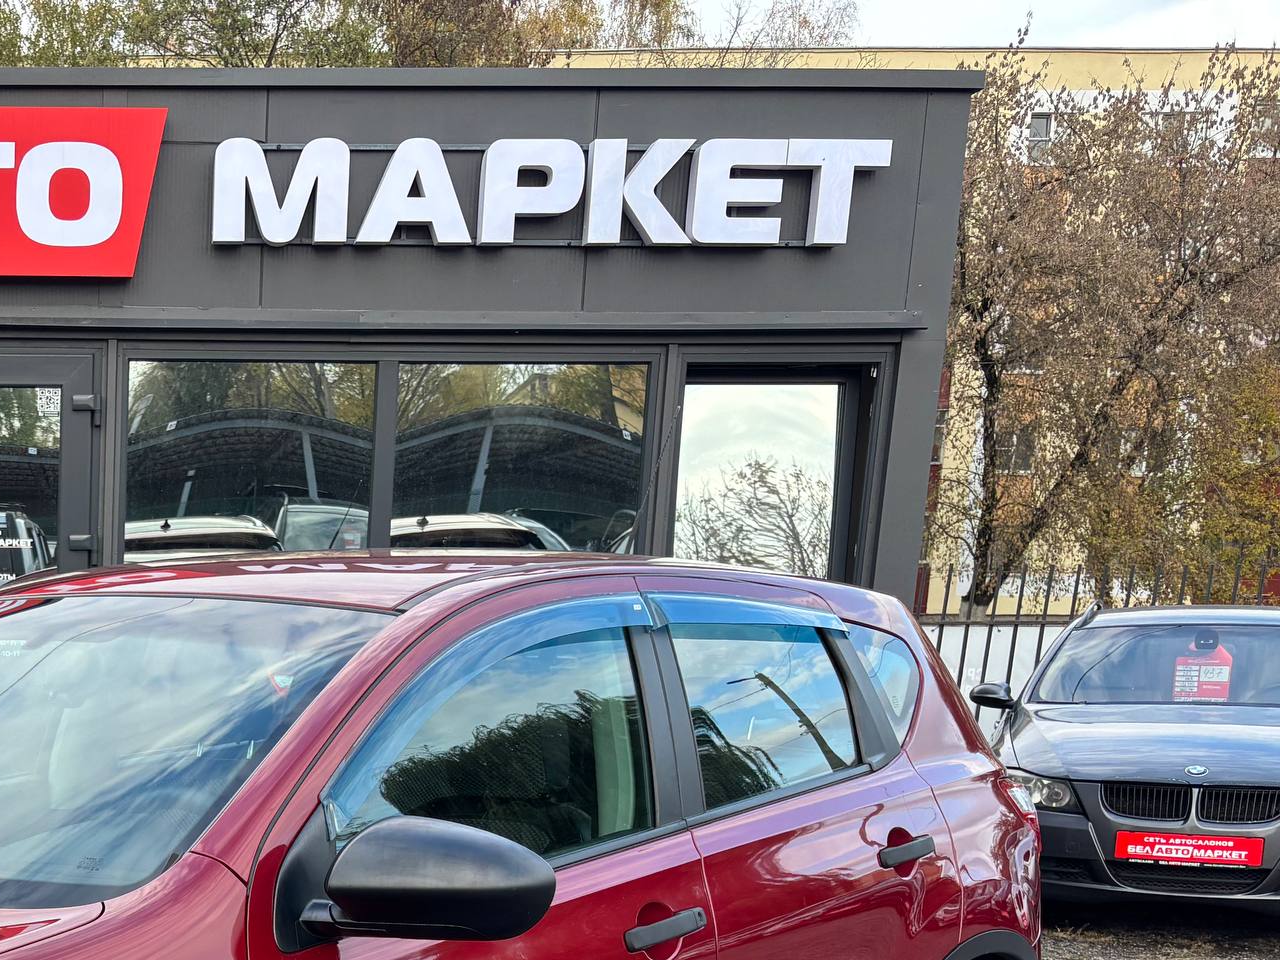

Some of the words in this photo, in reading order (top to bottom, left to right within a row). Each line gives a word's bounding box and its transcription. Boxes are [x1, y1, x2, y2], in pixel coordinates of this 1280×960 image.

[211, 137, 893, 247] МАРКЕТ
[1143, 836, 1167, 844] СЕТЬ
[1168, 838, 1234, 847] АВТОСАЛОНОВ
[1127, 845, 1152, 855] БЕЛ
[1154, 847, 1190, 857] АВТО
[1193, 849, 1248, 859] МАРКЕТ
